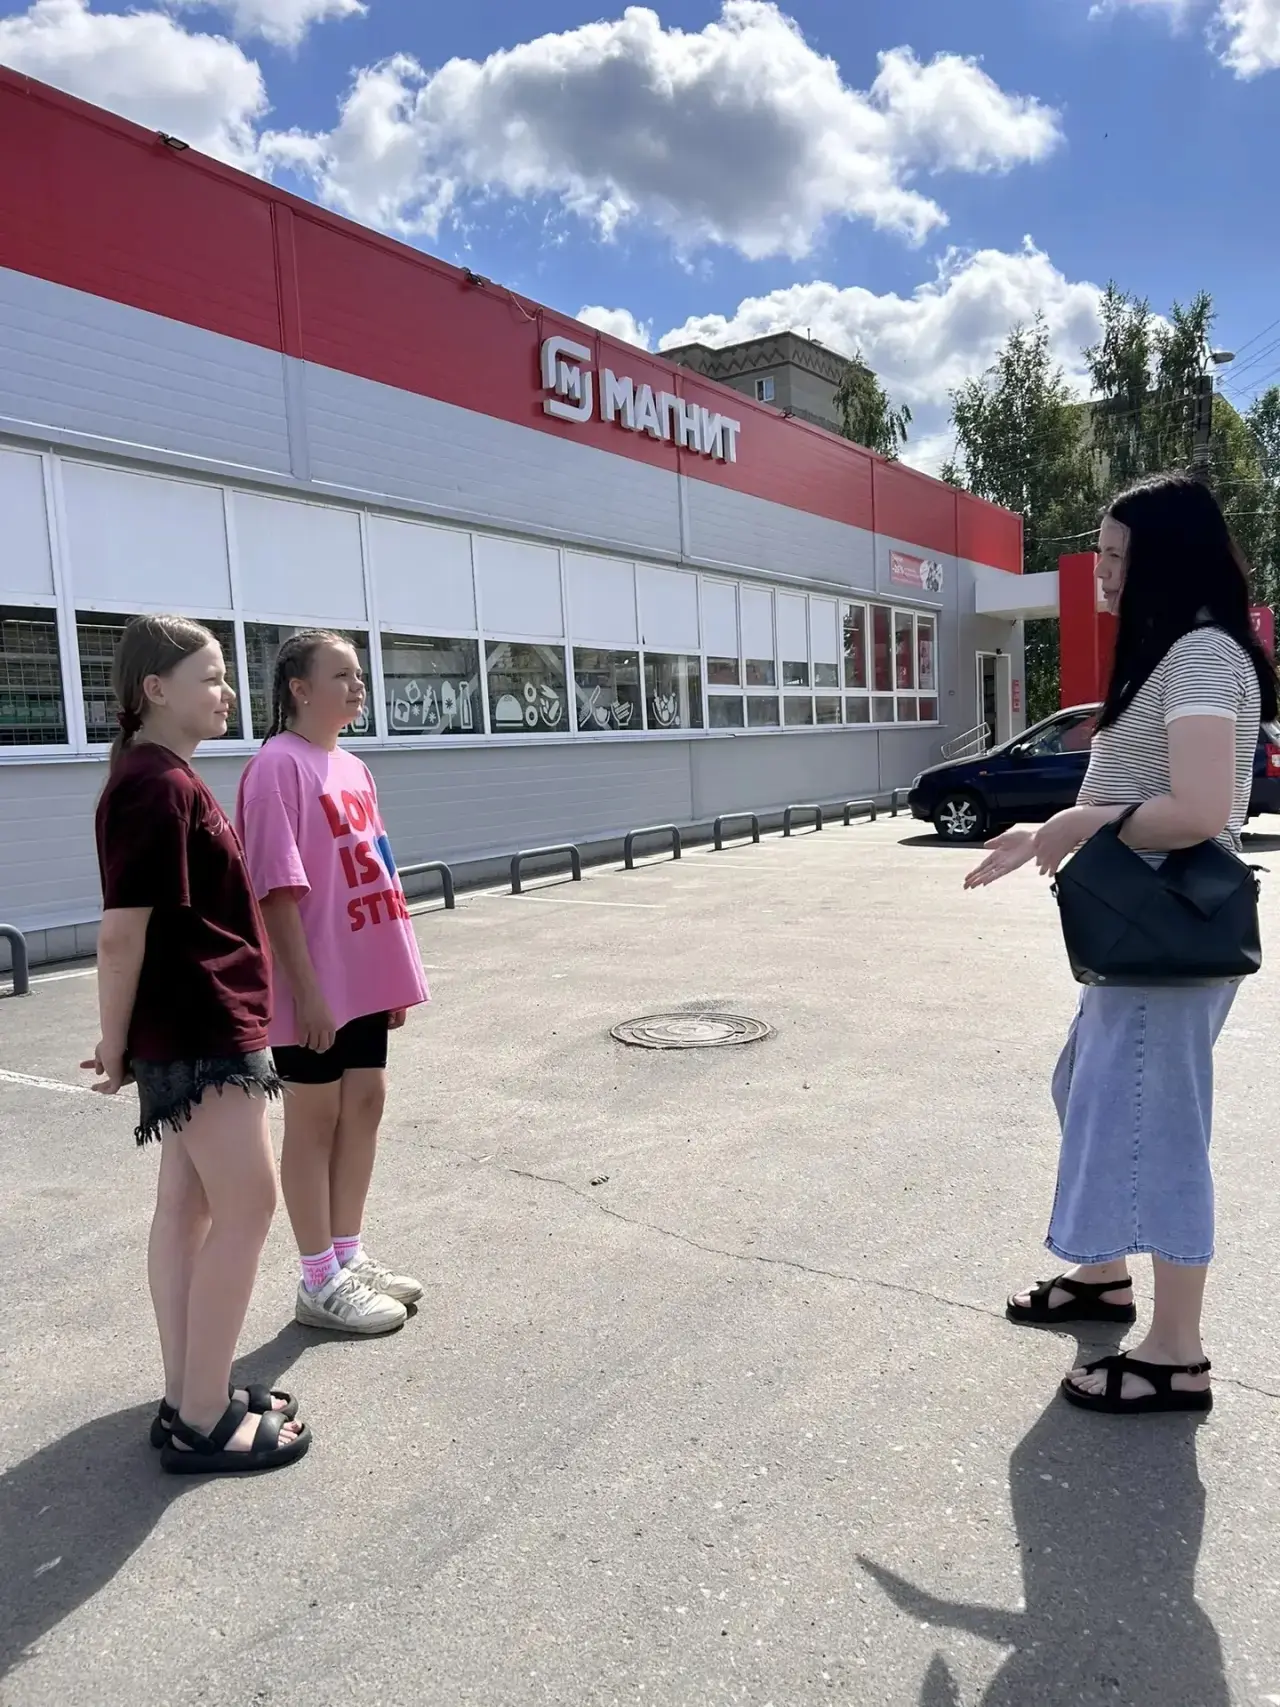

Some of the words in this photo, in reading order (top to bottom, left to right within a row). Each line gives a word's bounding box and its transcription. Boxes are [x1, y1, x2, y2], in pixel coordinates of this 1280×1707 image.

[600, 367, 741, 464] МАГНИТ
[318, 789, 383, 839] LOV
[338, 840, 381, 889] IS
[346, 889, 410, 932] STR
